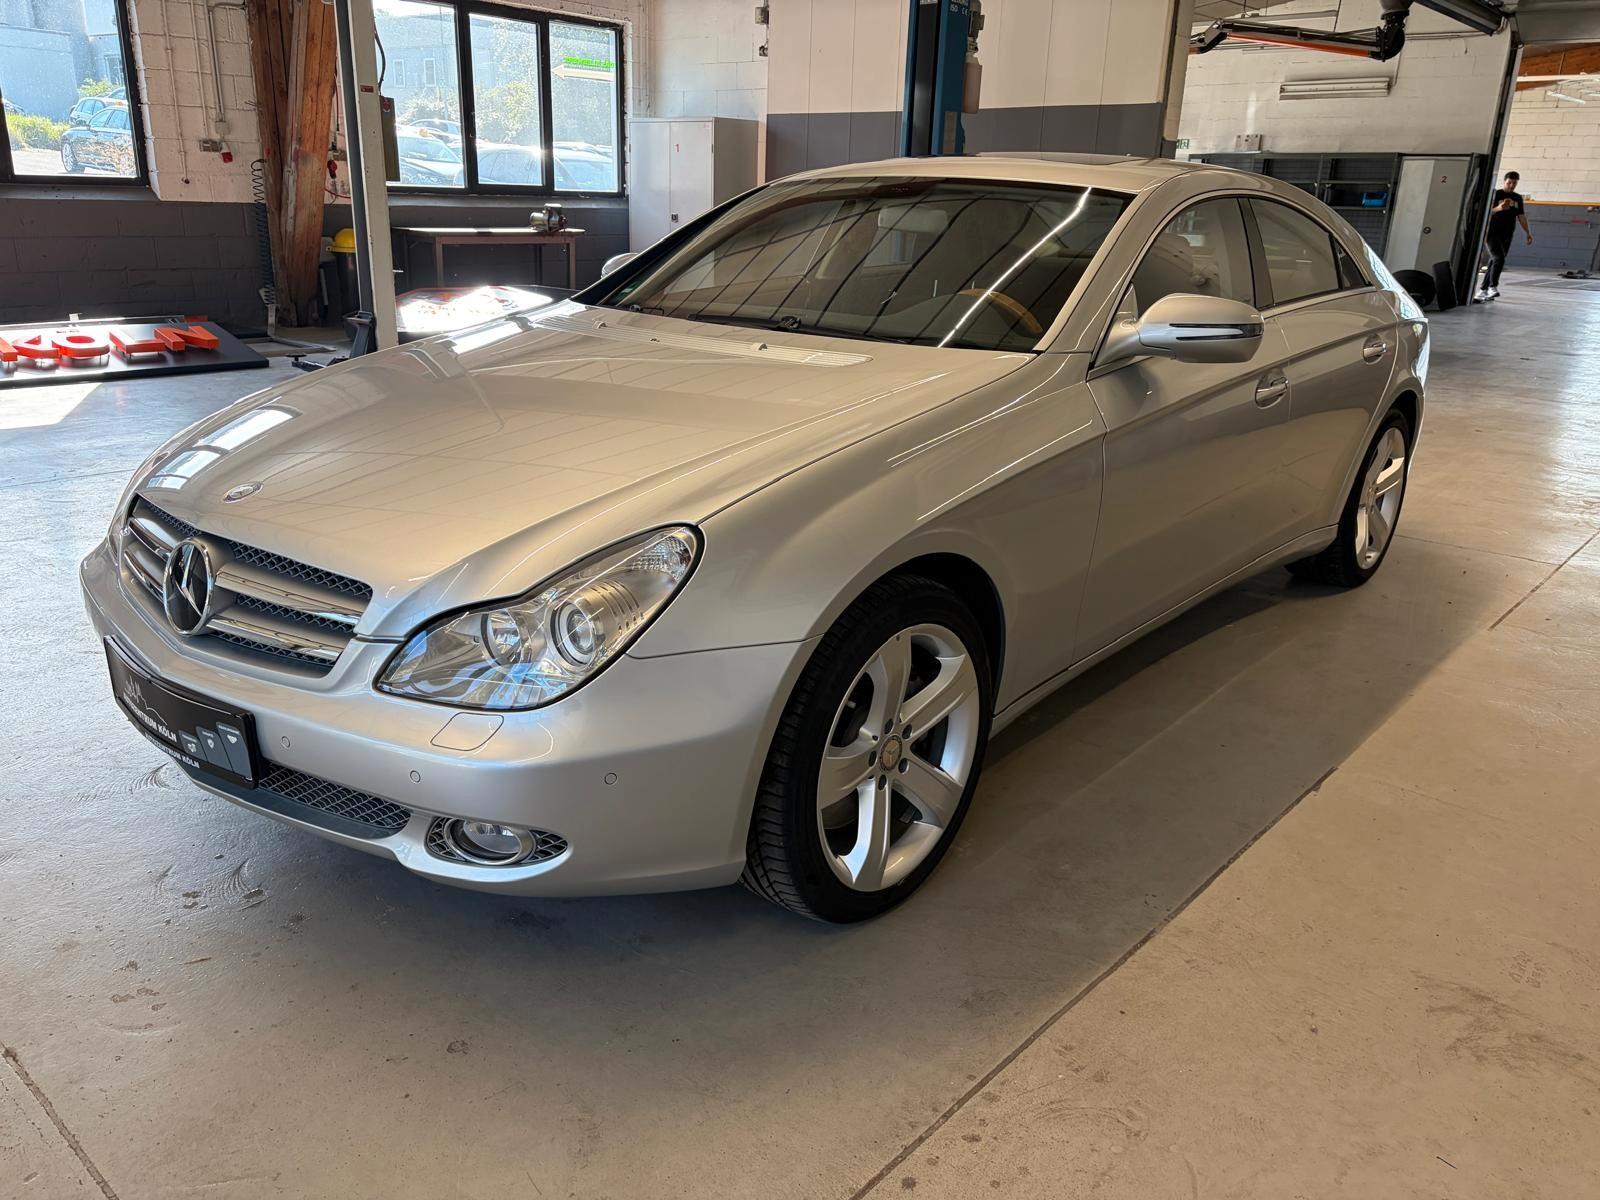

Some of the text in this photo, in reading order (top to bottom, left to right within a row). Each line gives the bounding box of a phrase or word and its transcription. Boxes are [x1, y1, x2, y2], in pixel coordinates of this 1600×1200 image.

[1441, 175, 1448, 183] 2
[158, 722, 178, 742] KÖLN
[181, 754, 200, 769] KÖLN
